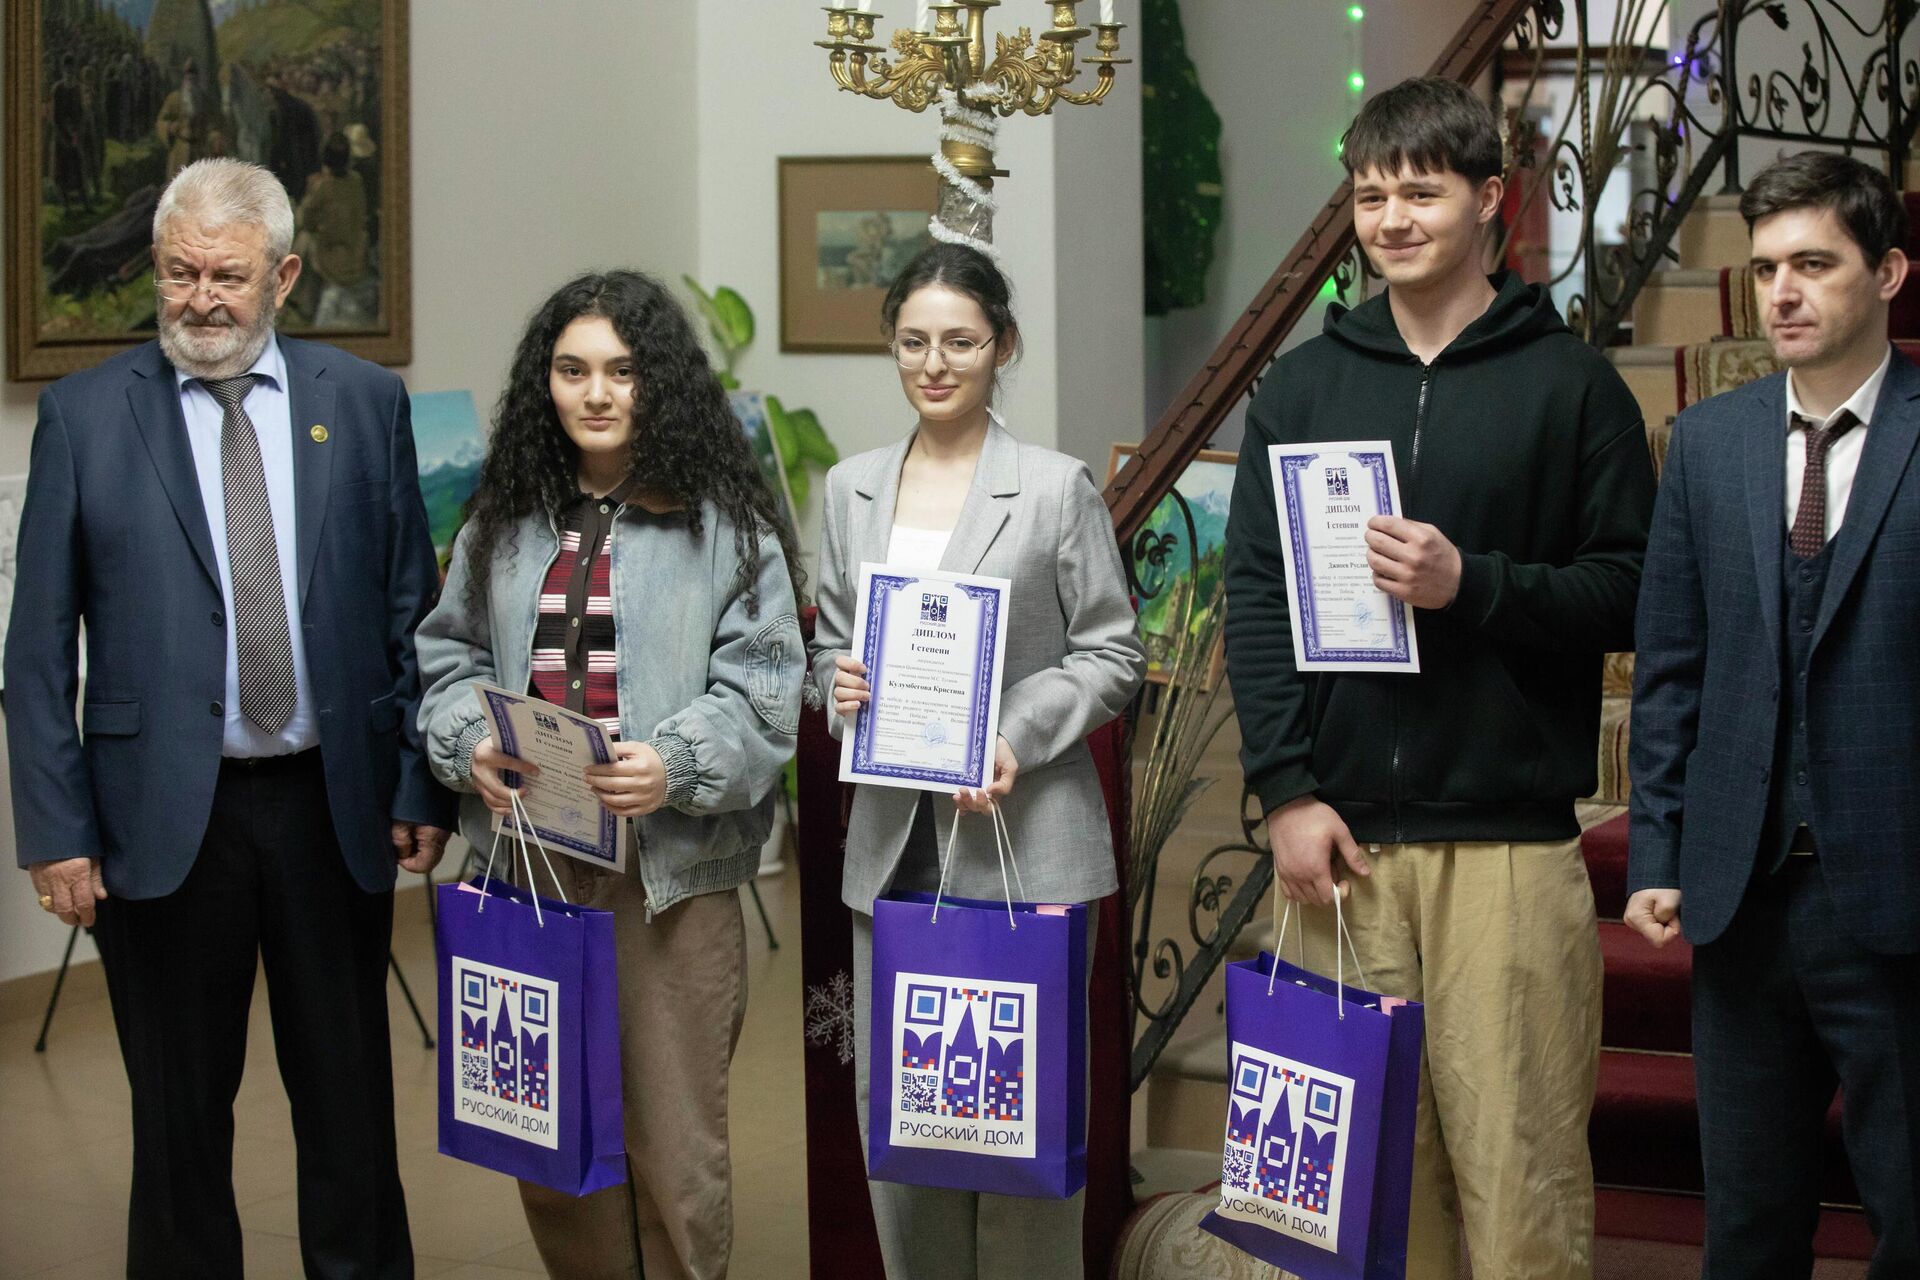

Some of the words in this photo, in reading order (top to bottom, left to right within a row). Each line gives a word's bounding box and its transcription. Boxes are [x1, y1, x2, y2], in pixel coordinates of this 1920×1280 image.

[1325, 504, 1361, 514] ДИПЛОМ
[1327, 521, 1331, 529] I
[1331, 521, 1359, 529] степени
[911, 628, 956, 641] ДИПЛОМ
[911, 643, 915, 651] I
[916, 645, 950, 655] степени
[888, 680, 932, 692] Кулумбегова
[933, 684, 965, 695] Кристина
[535, 729, 573, 746] ДИПЛОМ
[462, 1097, 518, 1126] РУССКИЙ
[521, 1115, 549, 1135] ДОМ
[899, 1121, 979, 1142] РУССКИЙ
[983, 1130, 1024, 1146] ДОМ
[1291, 1216, 1327, 1239] ДОМ
